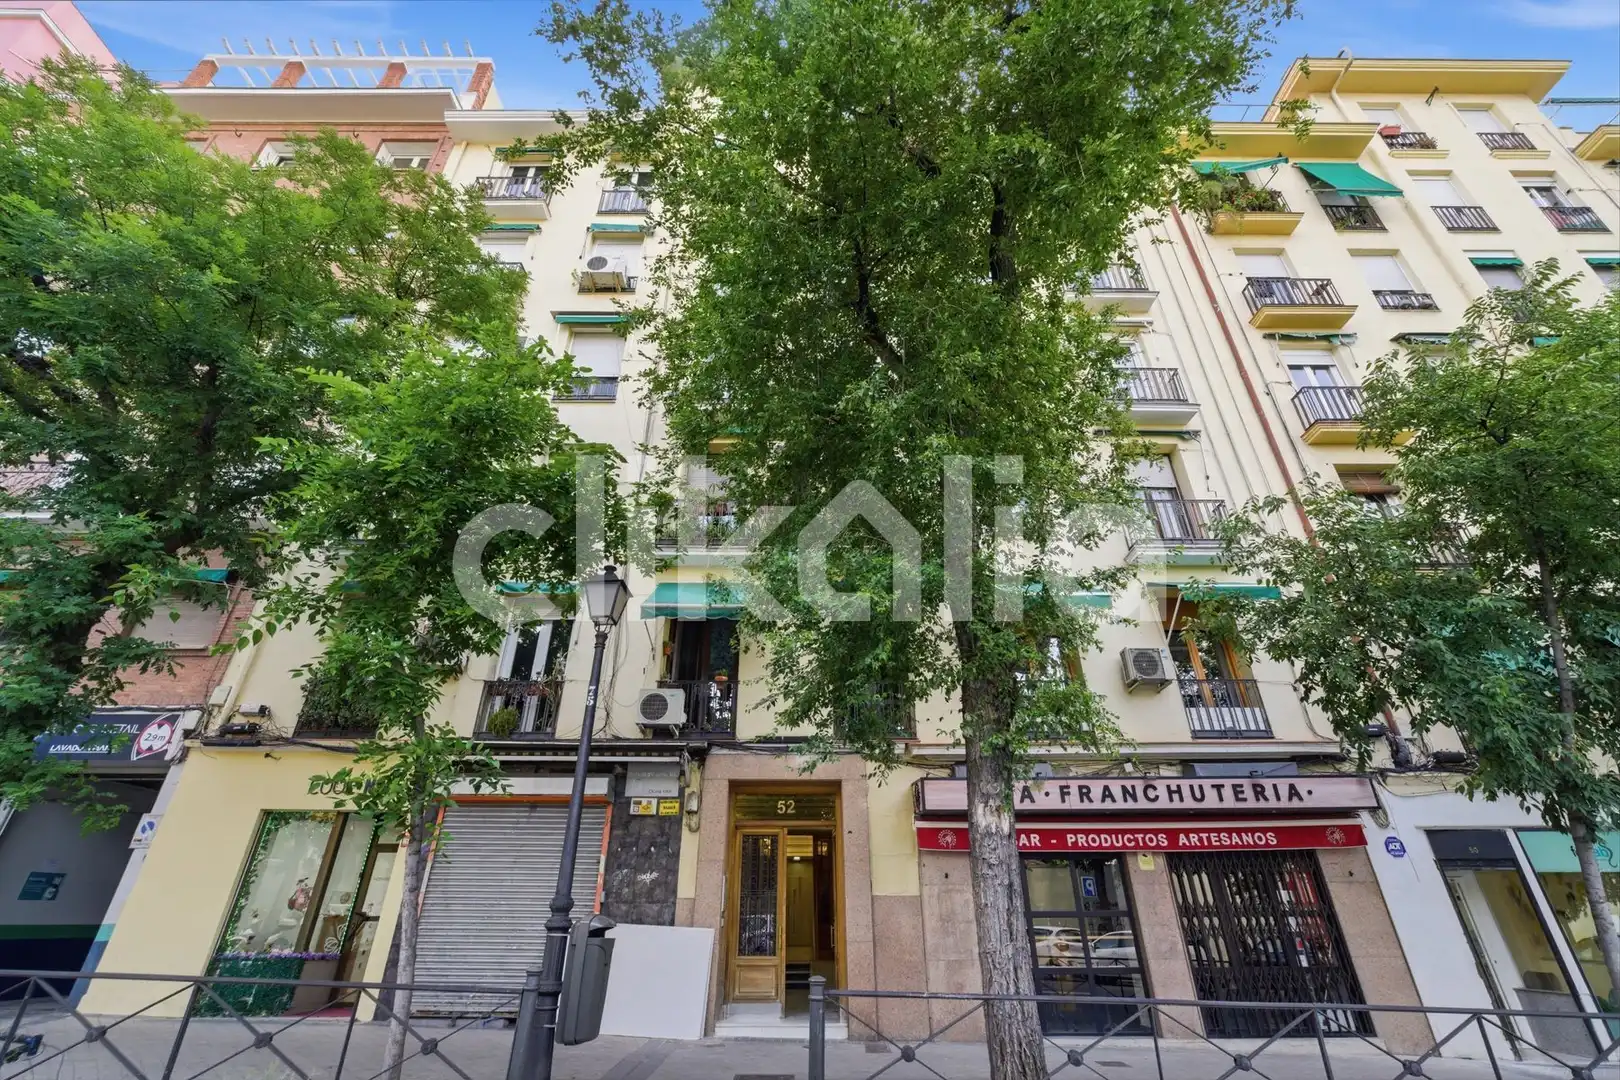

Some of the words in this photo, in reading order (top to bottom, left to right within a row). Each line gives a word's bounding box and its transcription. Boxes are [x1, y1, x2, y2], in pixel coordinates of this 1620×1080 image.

[1019, 784, 1036, 804] A
[1058, 783, 1304, 804] FRANCHUTERIA
[776, 800, 796, 814] 52
[1016, 834, 1041, 847] AR
[1066, 833, 1169, 847] PRODUCTOS
[1178, 832, 1277, 847] ARTESANOS
